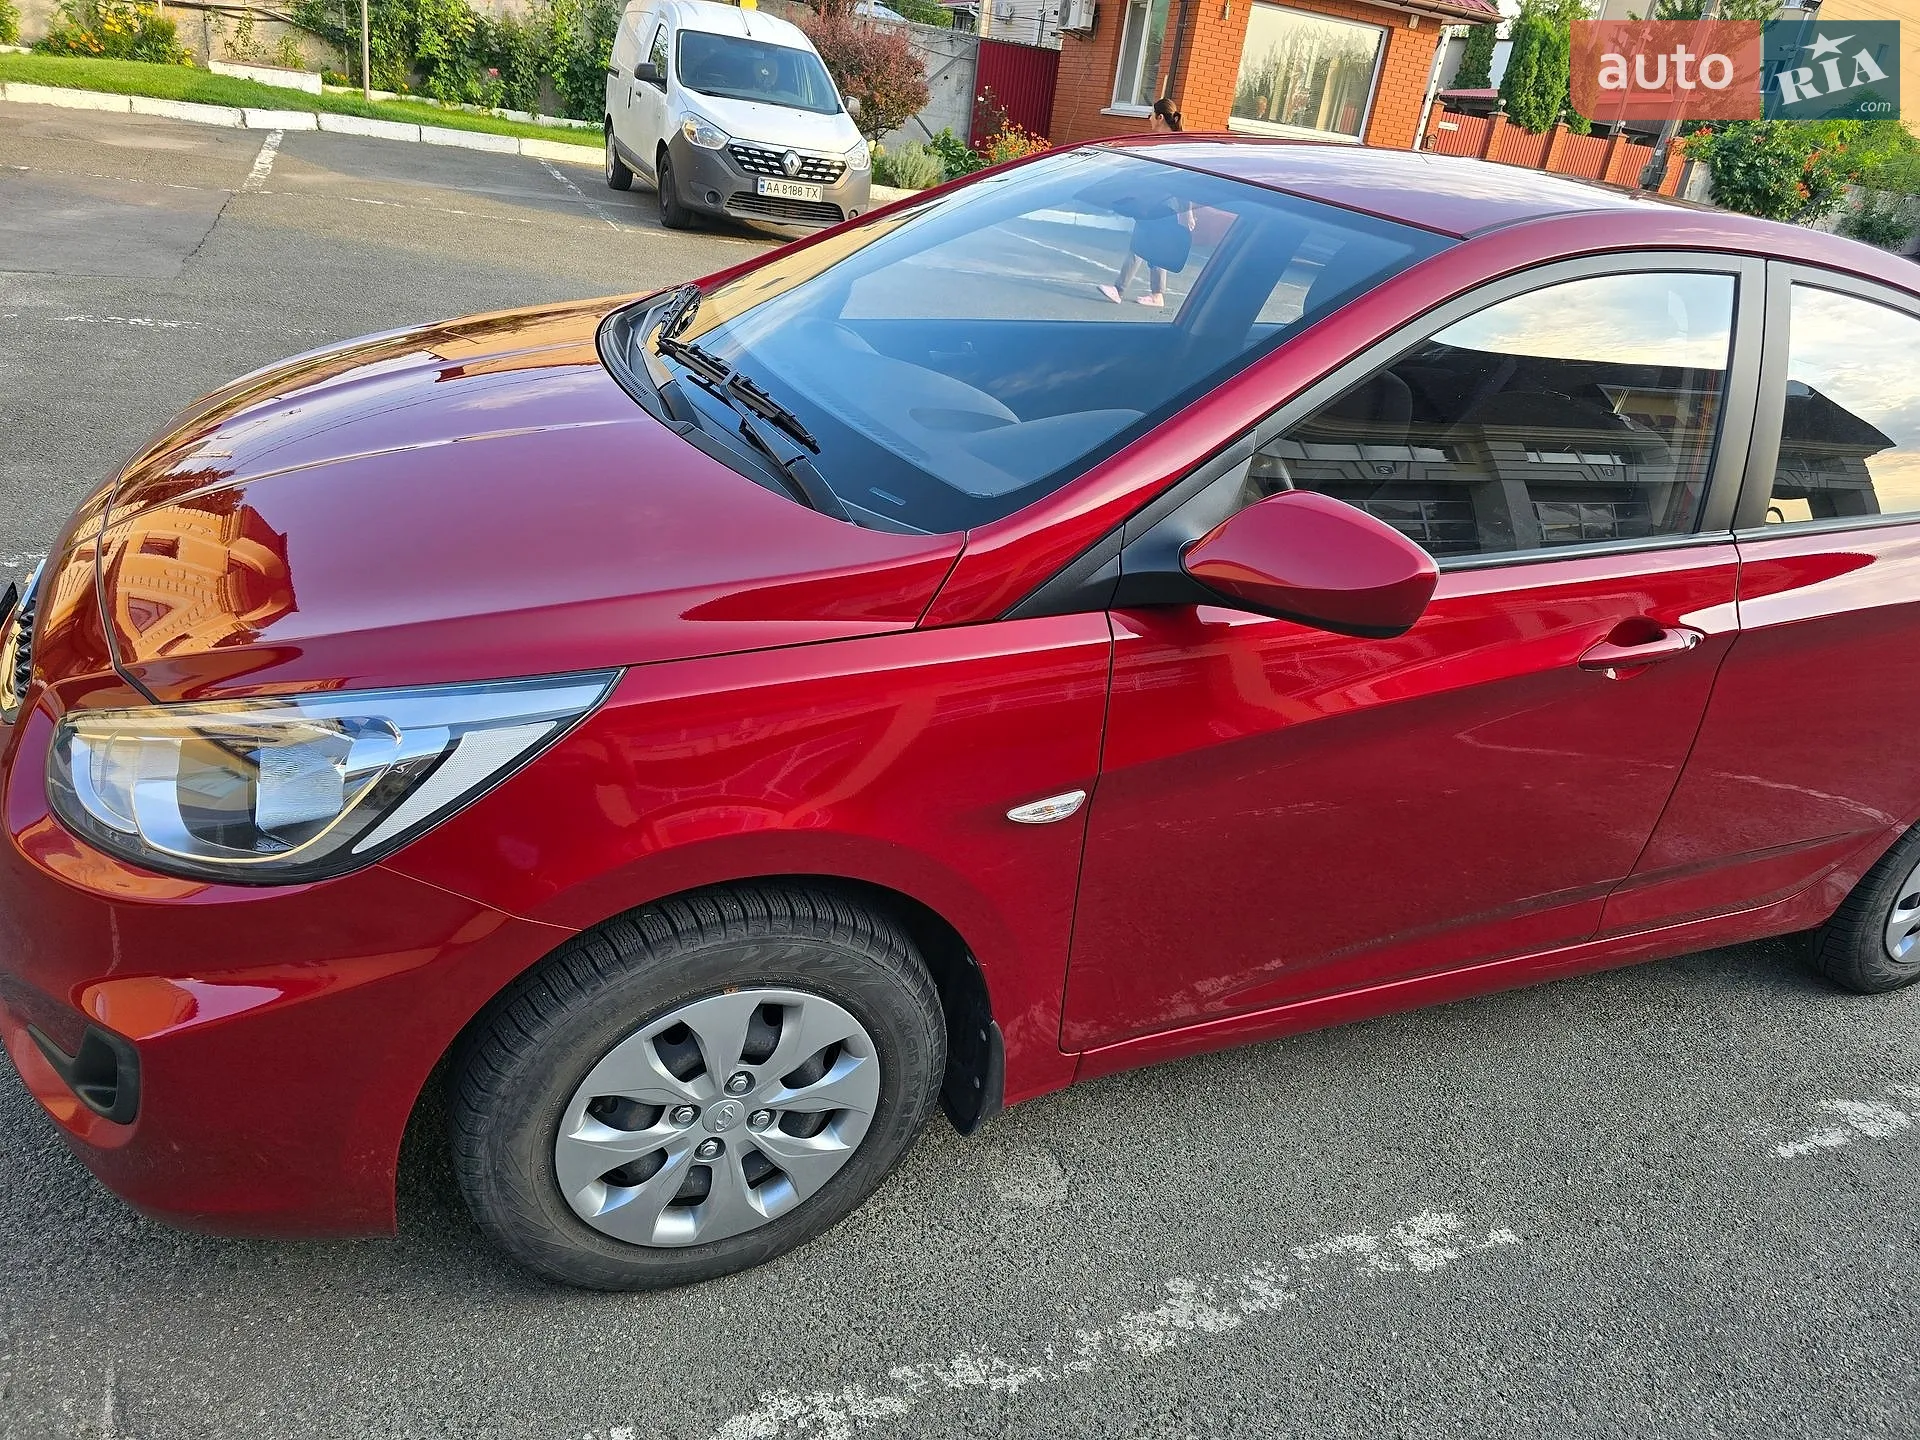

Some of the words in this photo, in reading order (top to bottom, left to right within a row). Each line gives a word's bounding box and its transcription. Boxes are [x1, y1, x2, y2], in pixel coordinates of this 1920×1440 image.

[766, 183, 779, 194] AA
[782, 185, 803, 196] 8188
[805, 187, 818, 199] TX
